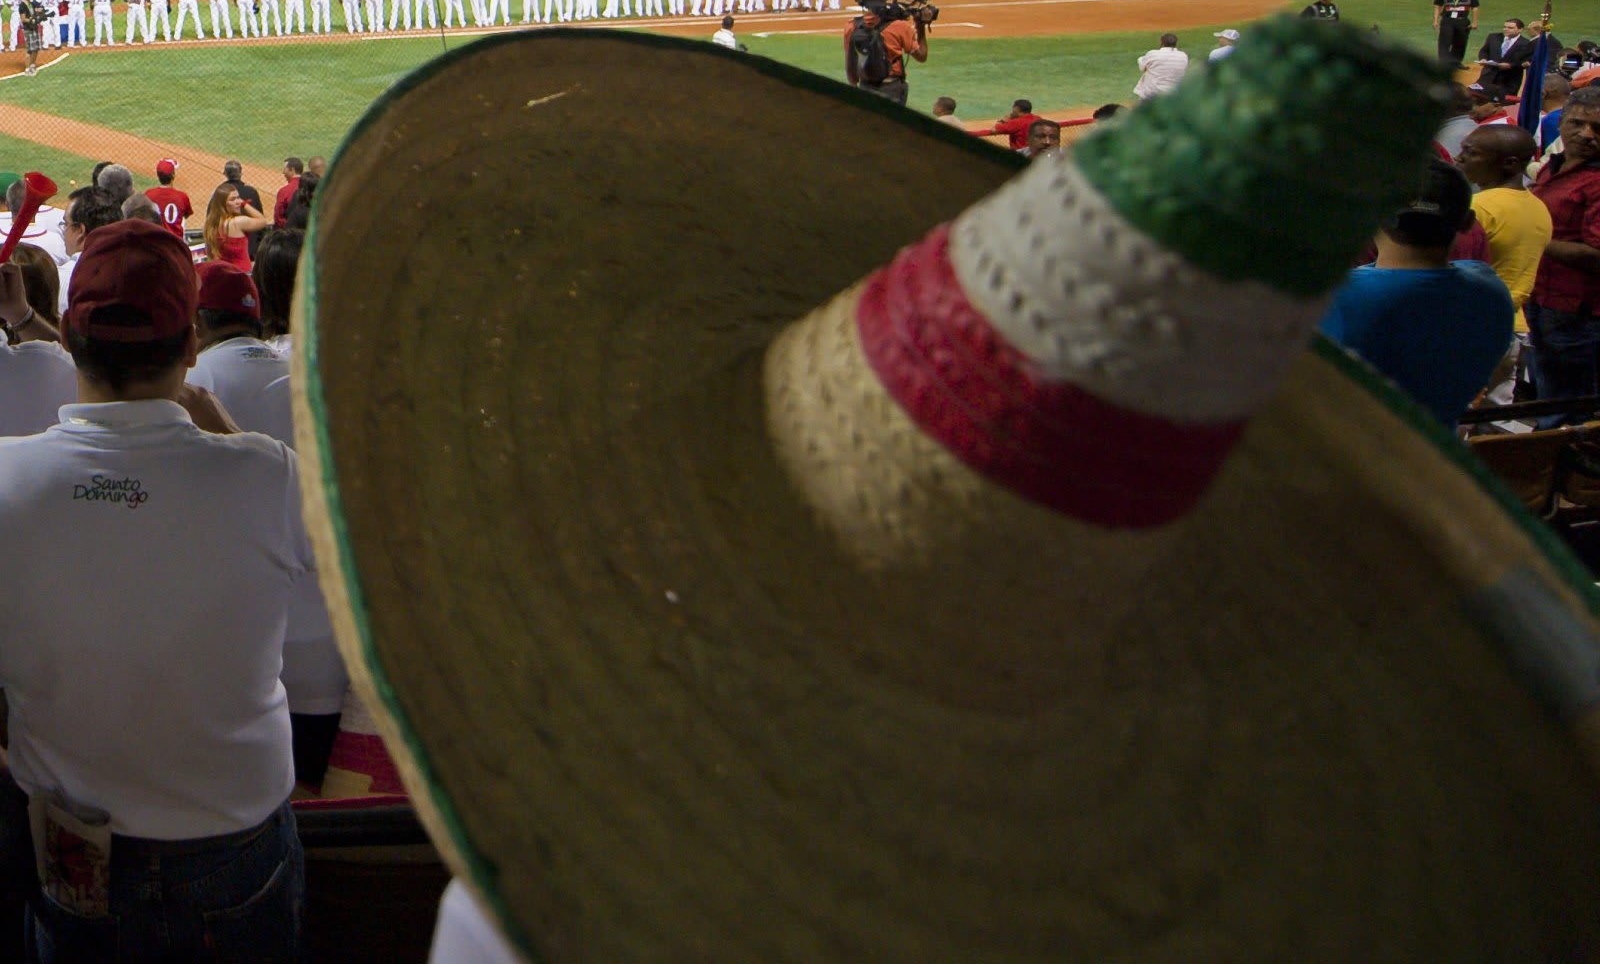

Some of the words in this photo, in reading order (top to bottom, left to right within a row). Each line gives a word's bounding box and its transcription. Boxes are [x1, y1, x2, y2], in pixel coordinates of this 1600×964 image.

[164, 203, 178, 224] 0
[92, 475, 141, 491] Santo
[73, 484, 148, 509] Domingo
